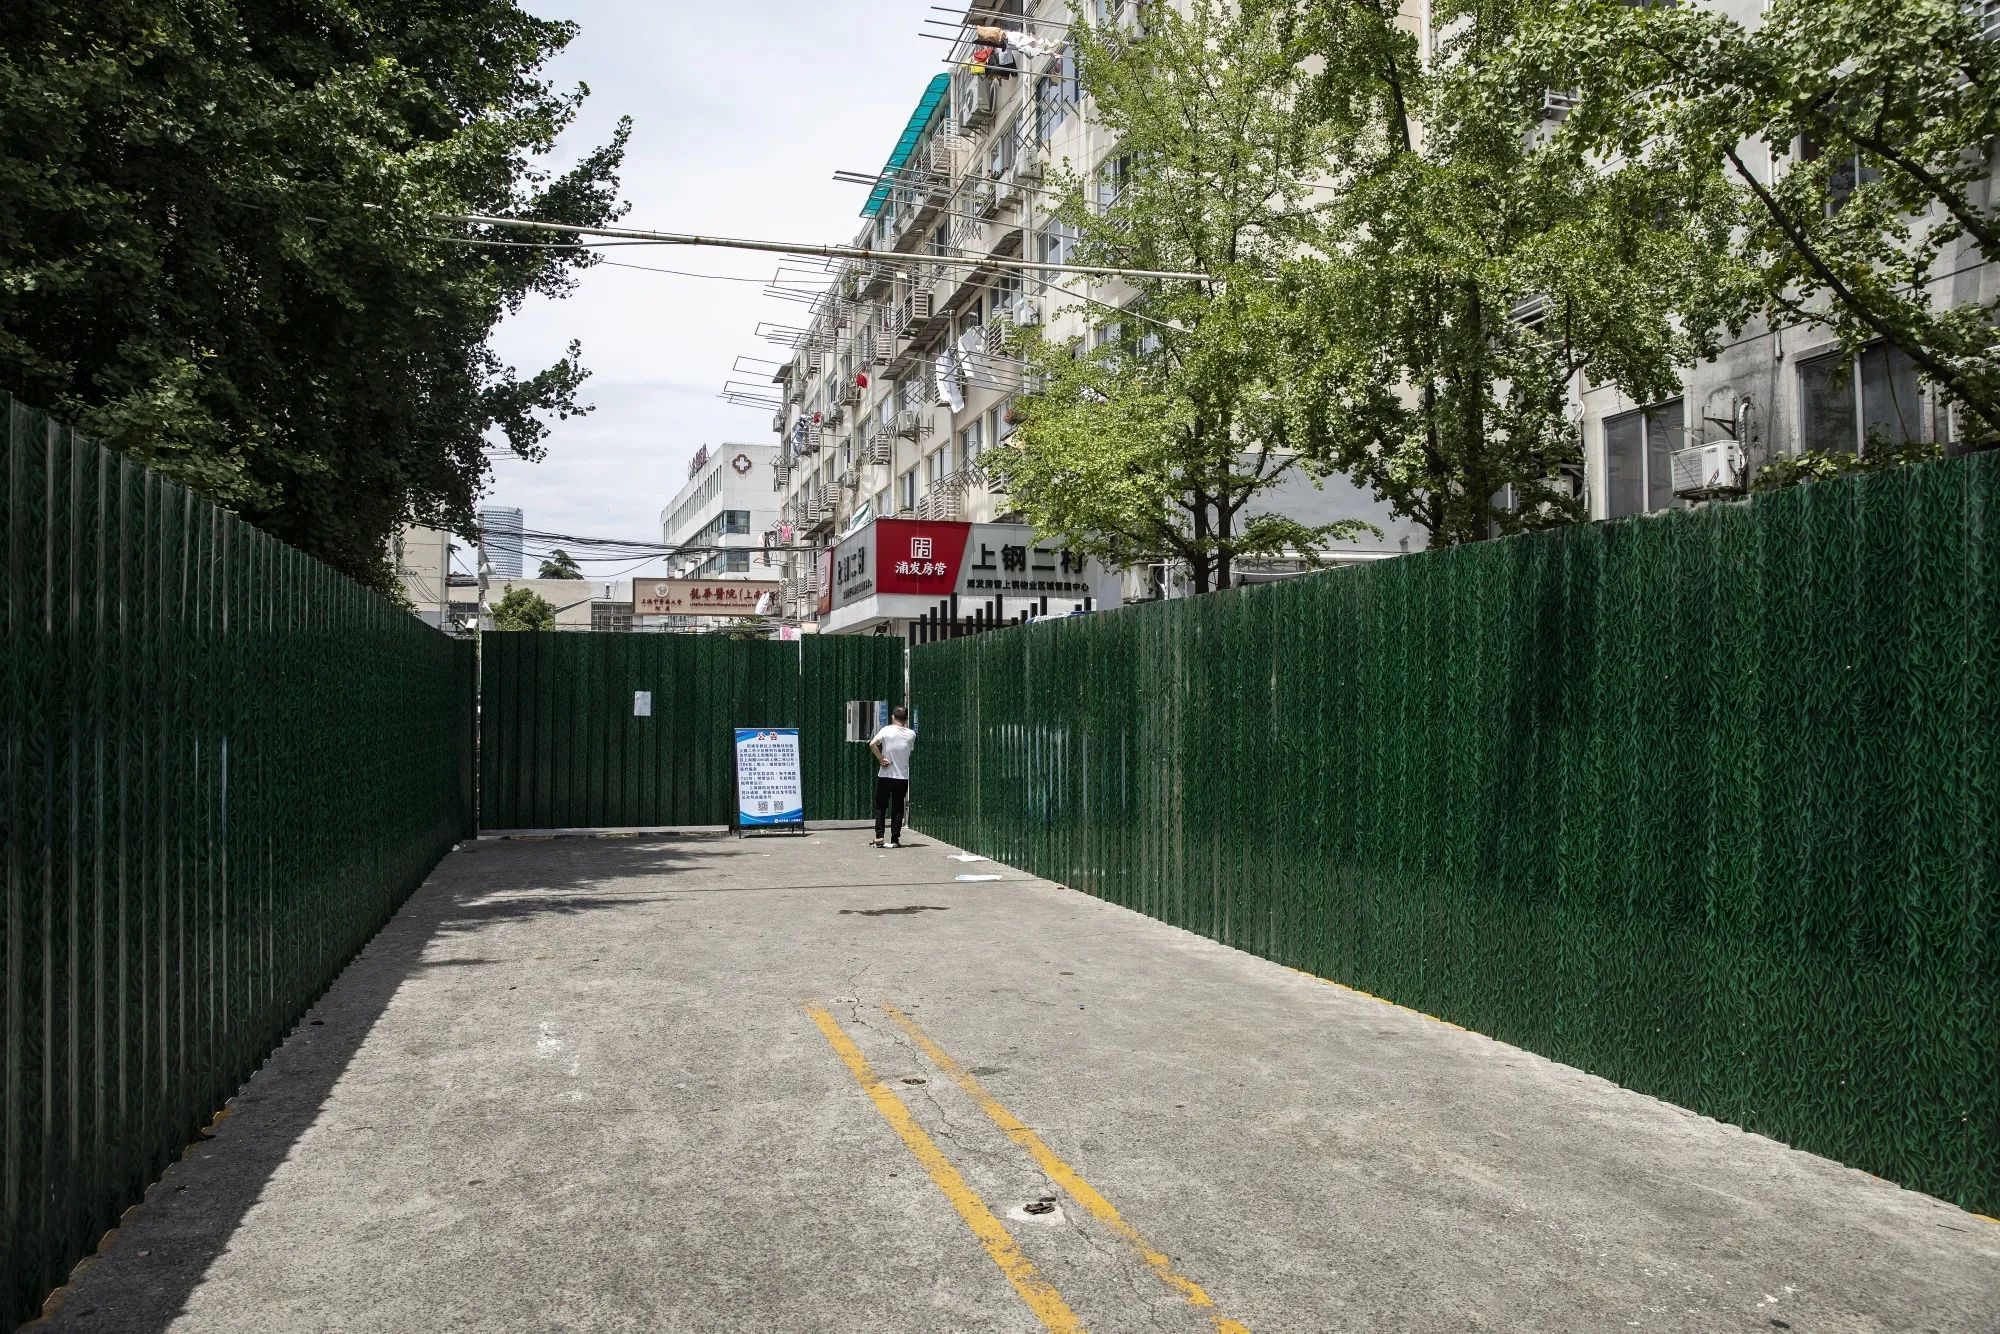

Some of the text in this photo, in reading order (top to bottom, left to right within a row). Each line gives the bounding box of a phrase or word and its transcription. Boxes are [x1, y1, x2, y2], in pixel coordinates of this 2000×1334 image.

[895, 561, 947, 576] 浦发房管
[966, 579, 1090, 592] 浦发房管上钢物业区域管理中心
[758, 732, 778, 740] 公告
